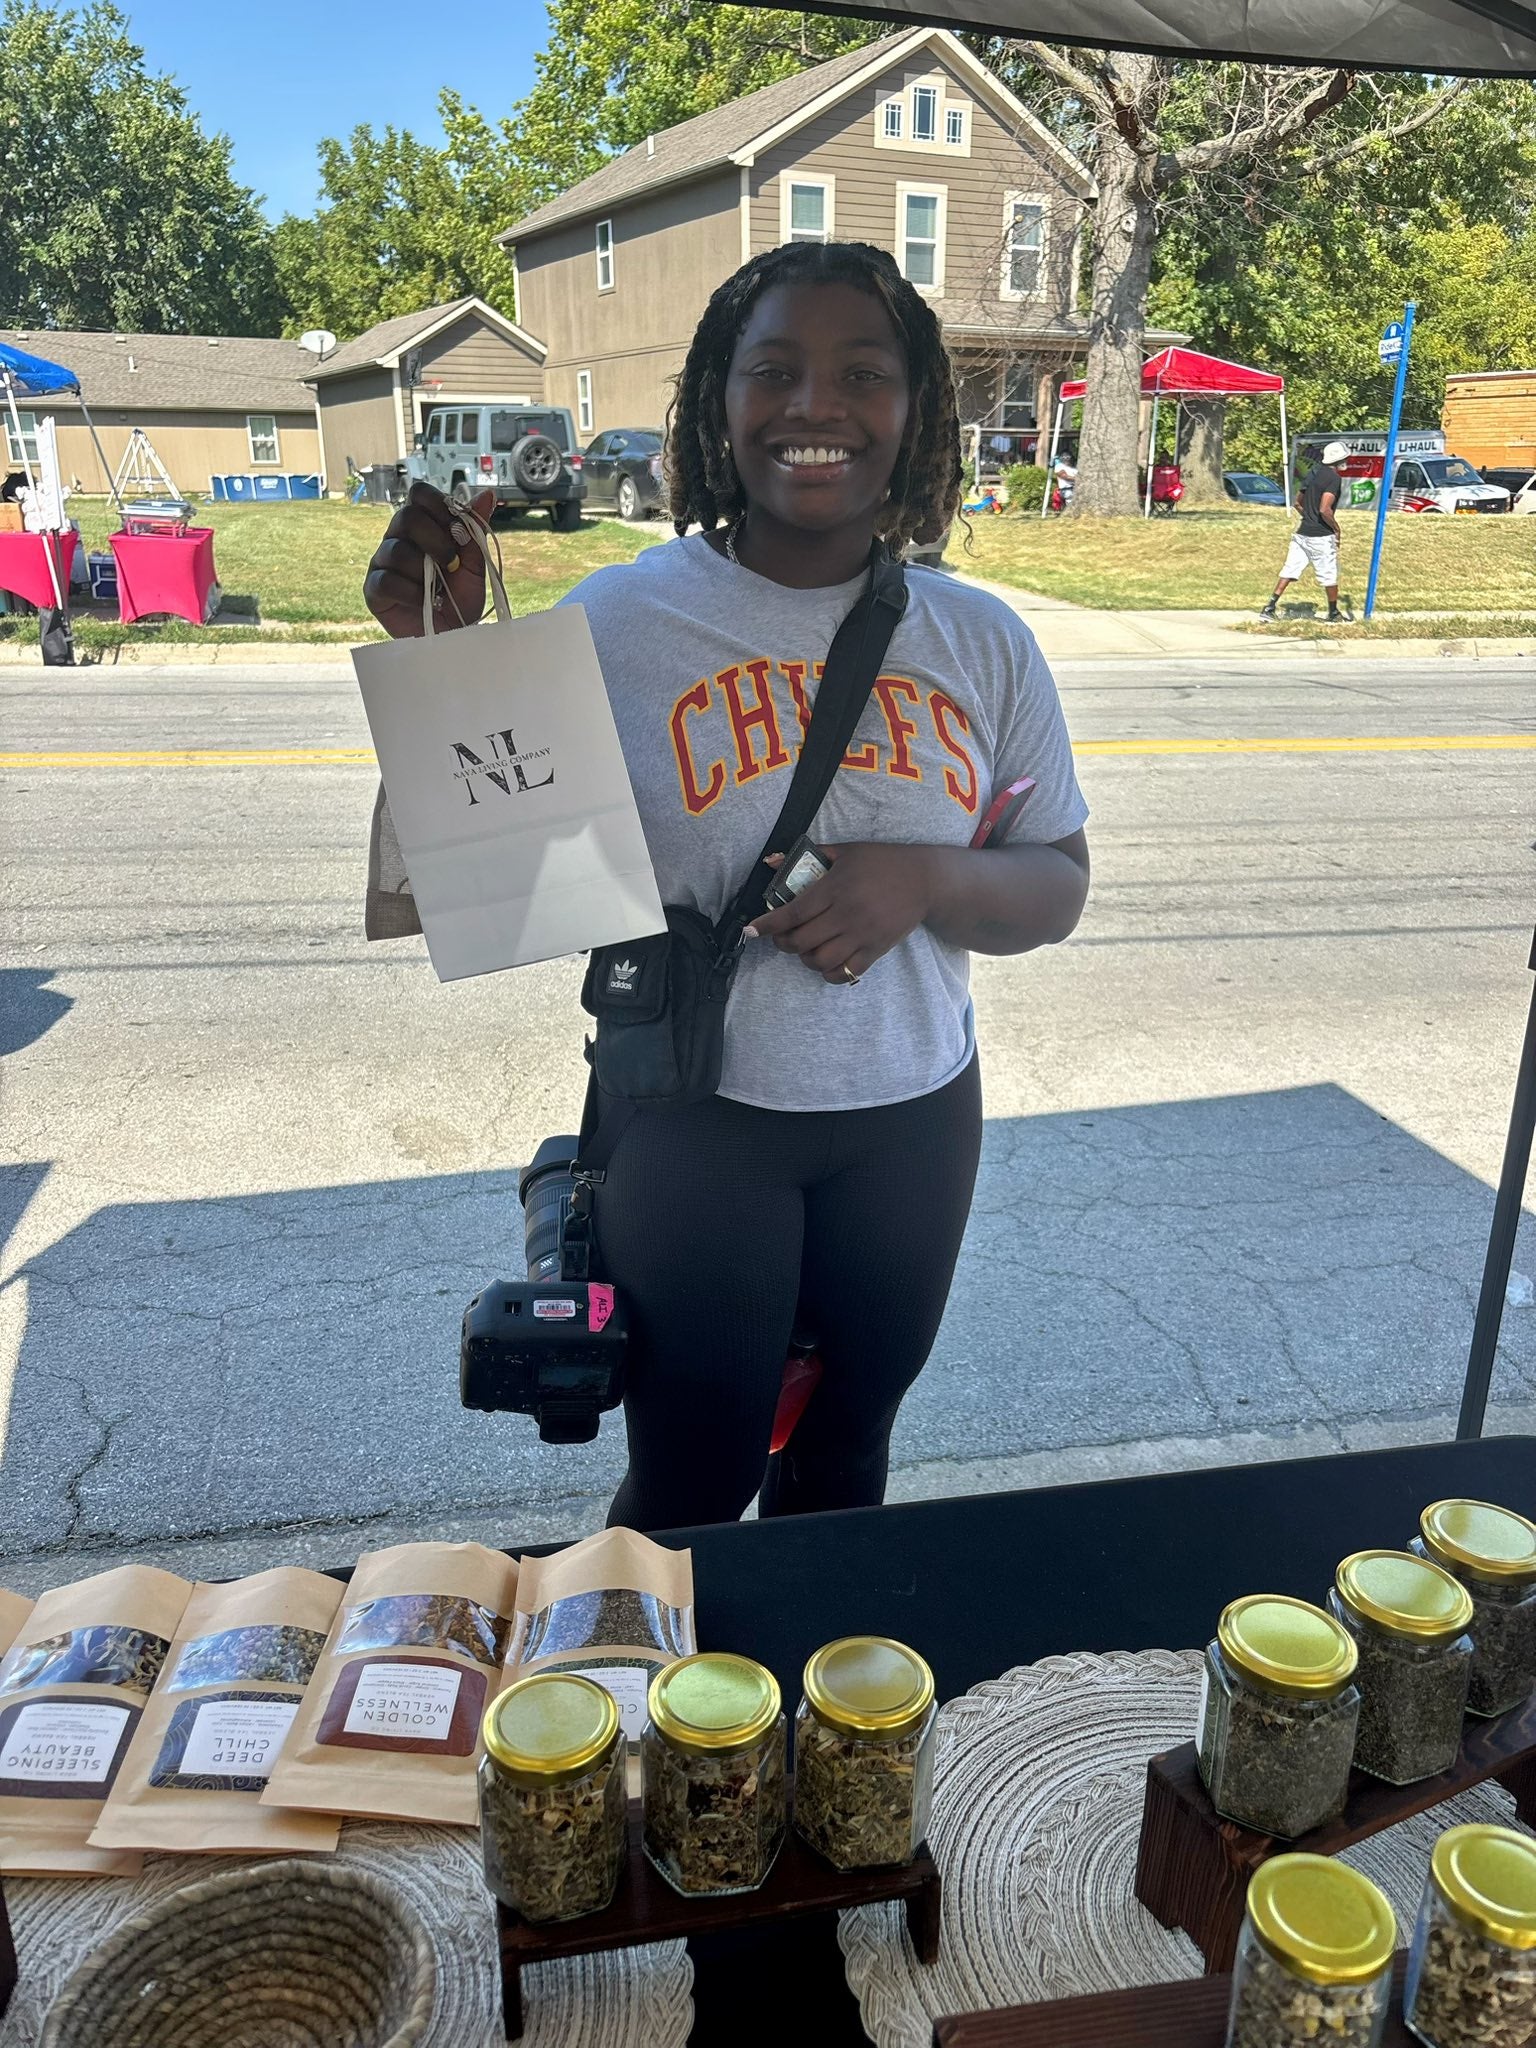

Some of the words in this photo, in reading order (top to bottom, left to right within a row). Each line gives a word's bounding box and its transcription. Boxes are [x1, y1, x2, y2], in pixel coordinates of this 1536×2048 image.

[1346, 443, 1381, 453] -HAUL
[1399, 441, 1438, 452] U-HAUL
[669, 656, 980, 816] CHIFS
[453, 768, 478, 780] NAVA
[478, 759, 508, 774] LIVING
[509, 747, 551, 765] COMPANY
[610, 980, 632, 990] adidas
[355, 1697, 449, 1714] WELLNESS
[617, 1703, 638, 1714] CL
[362, 1710, 436, 1726] GOLDEN
[20, 1743, 96, 1757] BEAUTY
[213, 1737, 270, 1750] CHILL
[6, 1755, 101, 1770] SLEEPING
[211, 1751, 264, 1763] DEEP
